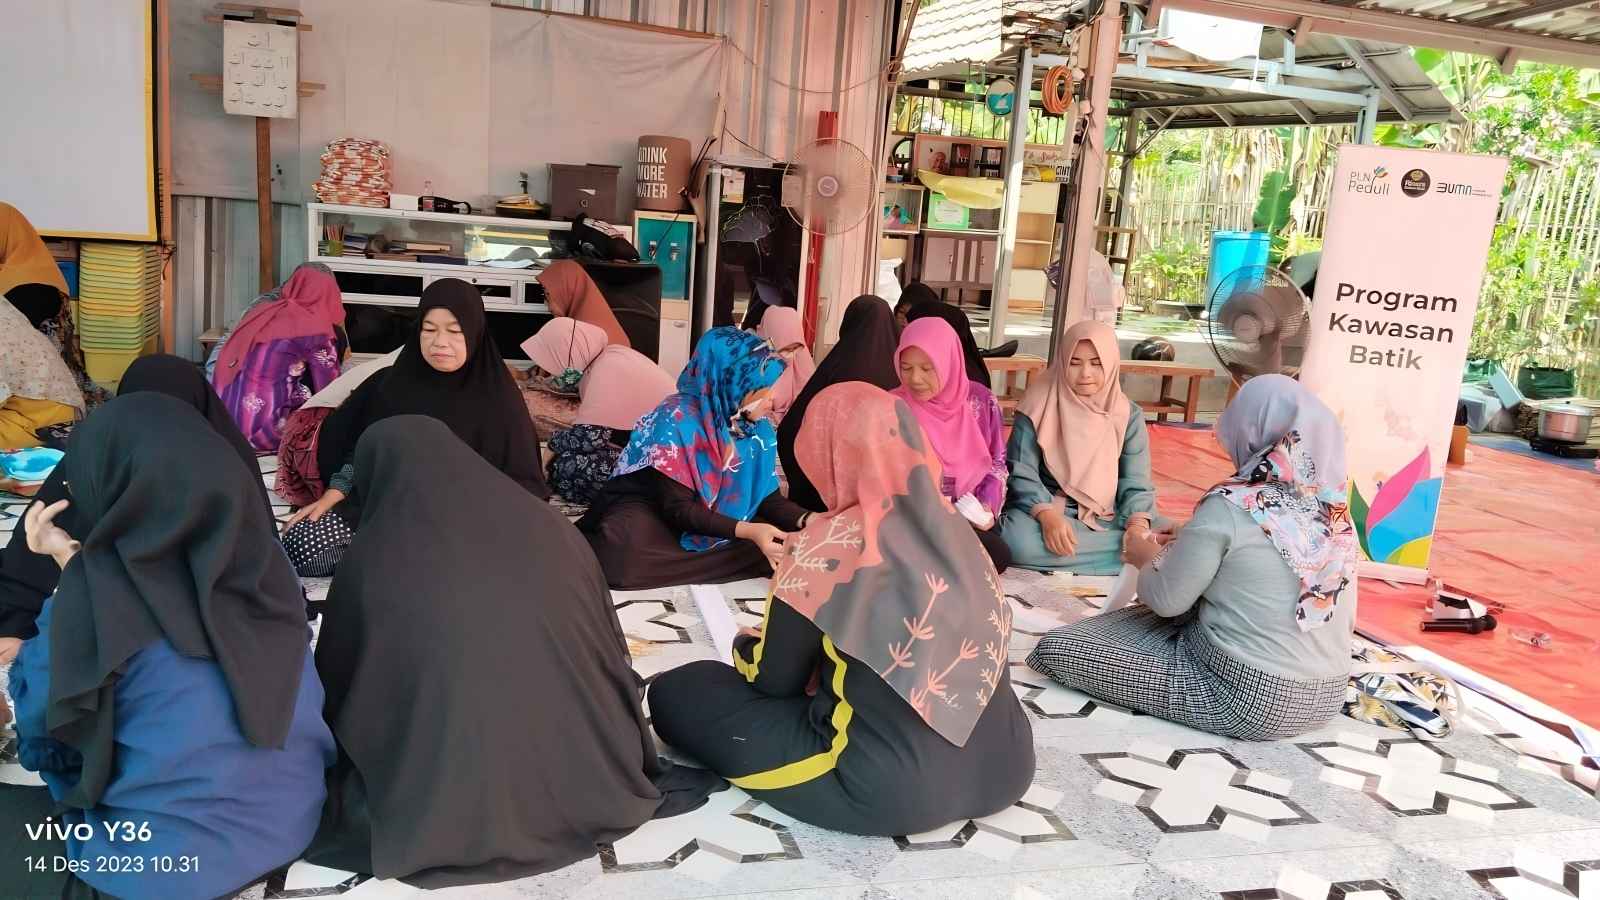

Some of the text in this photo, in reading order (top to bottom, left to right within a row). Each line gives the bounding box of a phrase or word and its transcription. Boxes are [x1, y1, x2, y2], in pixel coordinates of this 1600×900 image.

[1347, 181, 1391, 196] Peduli
[1350, 171, 1371, 182] PLN
[1335, 282, 1458, 313] Program
[1328, 313, 1454, 343] Kawasan
[1349, 345, 1423, 371] Batik
